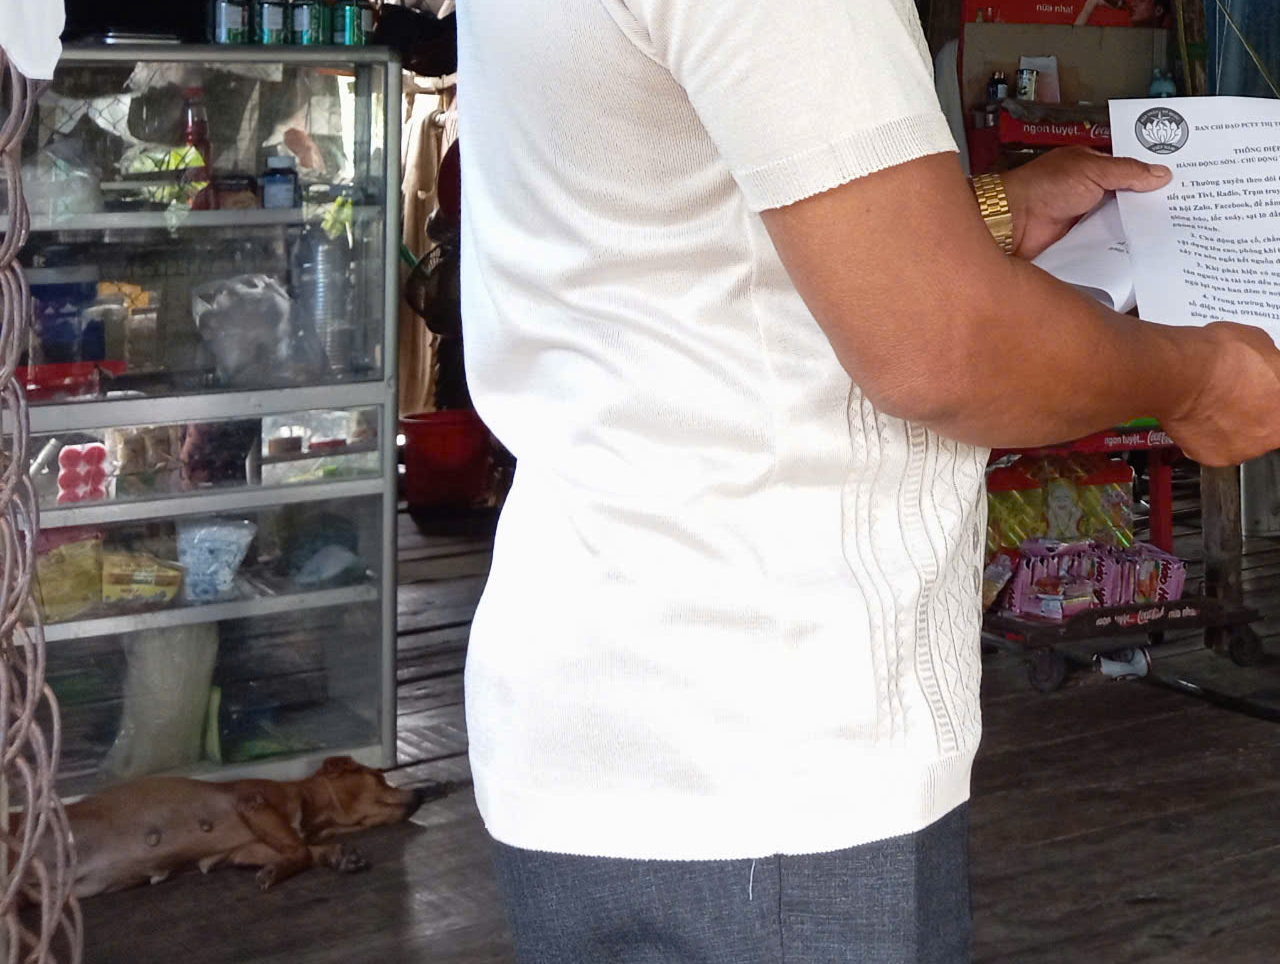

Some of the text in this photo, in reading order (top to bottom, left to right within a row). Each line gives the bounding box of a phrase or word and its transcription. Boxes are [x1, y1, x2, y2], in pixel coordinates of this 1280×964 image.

[1055, 3, 1074, 14] nha!
[1024, 123, 1049, 135] ngon
[1232, 146, 1261, 154] THÔNG
